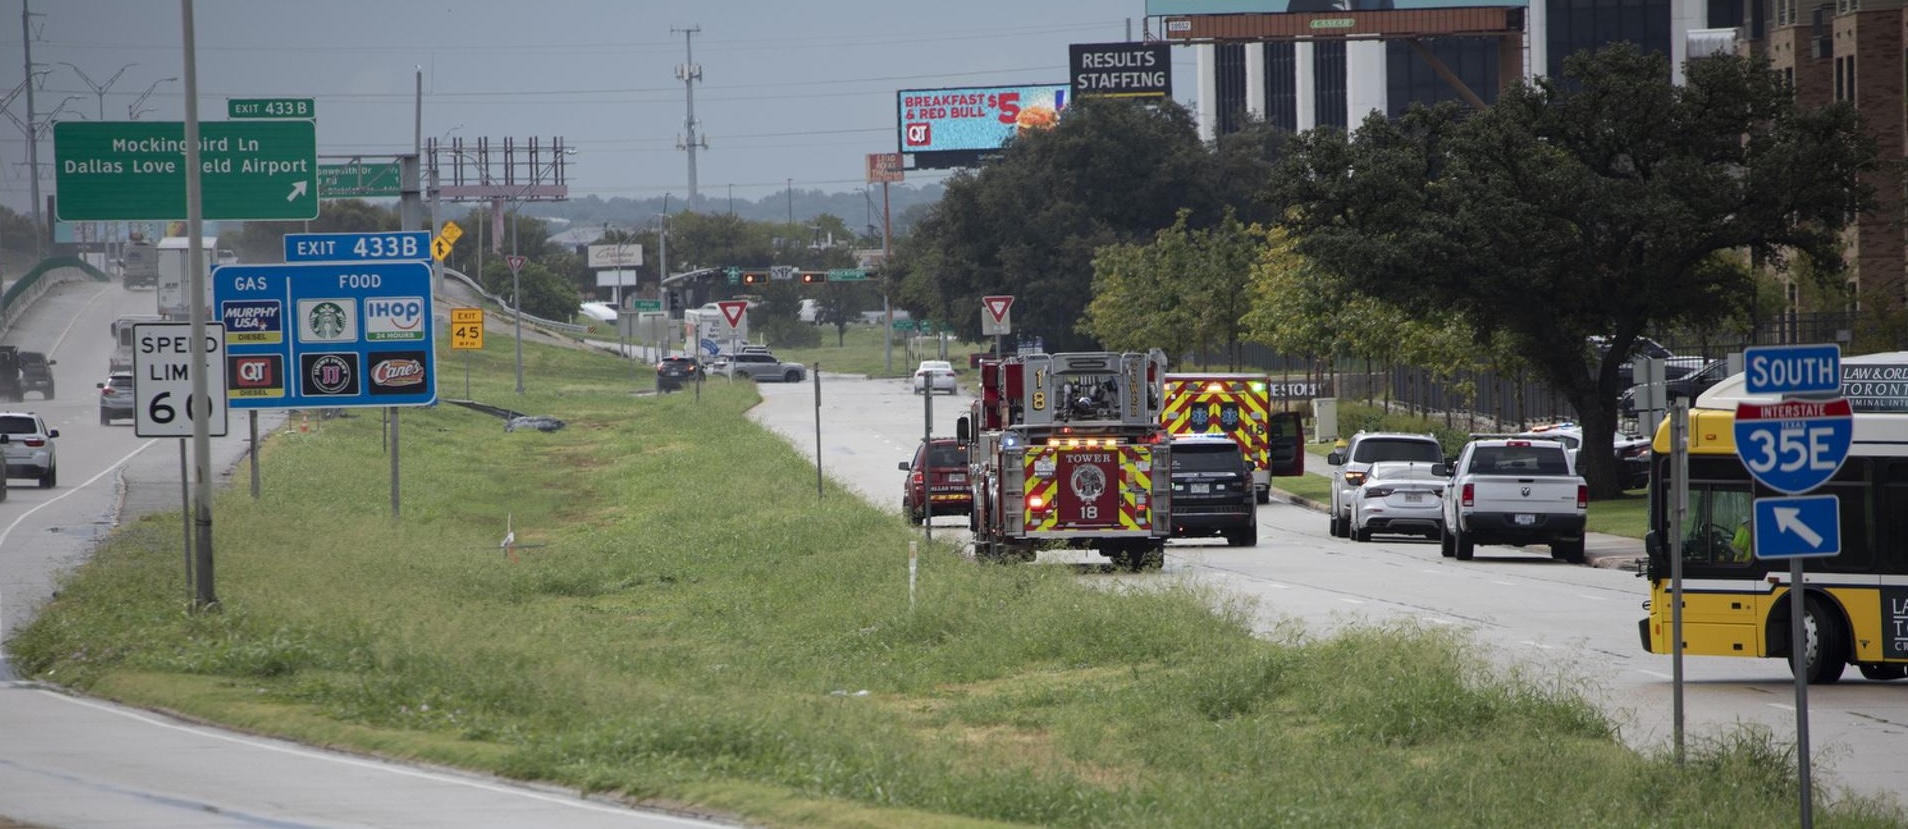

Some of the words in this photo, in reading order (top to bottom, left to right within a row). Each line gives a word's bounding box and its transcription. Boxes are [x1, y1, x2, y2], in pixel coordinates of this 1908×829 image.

[1082, 51, 1156, 68] RESULTS
[1077, 71, 1165, 89] STAFFING
[905, 94, 985, 107] BREAKFAST
[235, 104, 259, 113] EXIT
[905, 110, 915, 120] &
[920, 108, 947, 119] RED
[951, 107, 985, 118] BULL
[909, 125, 927, 142] QT
[112, 138, 228, 155] Mockingird
[239, 138, 259, 151] Ln
[64, 159, 123, 174] Dallas
[134, 160, 176, 173] Love
[202, 159, 231, 173] eld
[241, 158, 308, 176] Airport
[297, 240, 336, 256] EXIT
[353, 236, 418, 257] 433B
[234, 276, 268, 291] GAS
[339, 274, 381, 289] FOOD
[224, 306, 278, 318] MURPHY
[234, 318, 259, 328] USA
[238, 333, 267, 341] DIESEL
[456, 326, 479, 339] 45
[141, 337, 217, 353] SPED
[150, 364, 209, 380] LIM
[240, 362, 266, 382] QT
[1752, 356, 1834, 387] SOUTH
[1843, 368, 1873, 379] LAW
[1872, 368, 1883, 379] &
[239, 389, 268, 397] DIESEL
[1760, 404, 1826, 419] INTERSTATE
[1781, 421, 1807, 430] TEXAS
[1749, 427, 1837, 473] 35E
[1066, 454, 1111, 463] TOWER
[1080, 506, 1098, 519] 18
[1893, 620, 1908, 636] T
